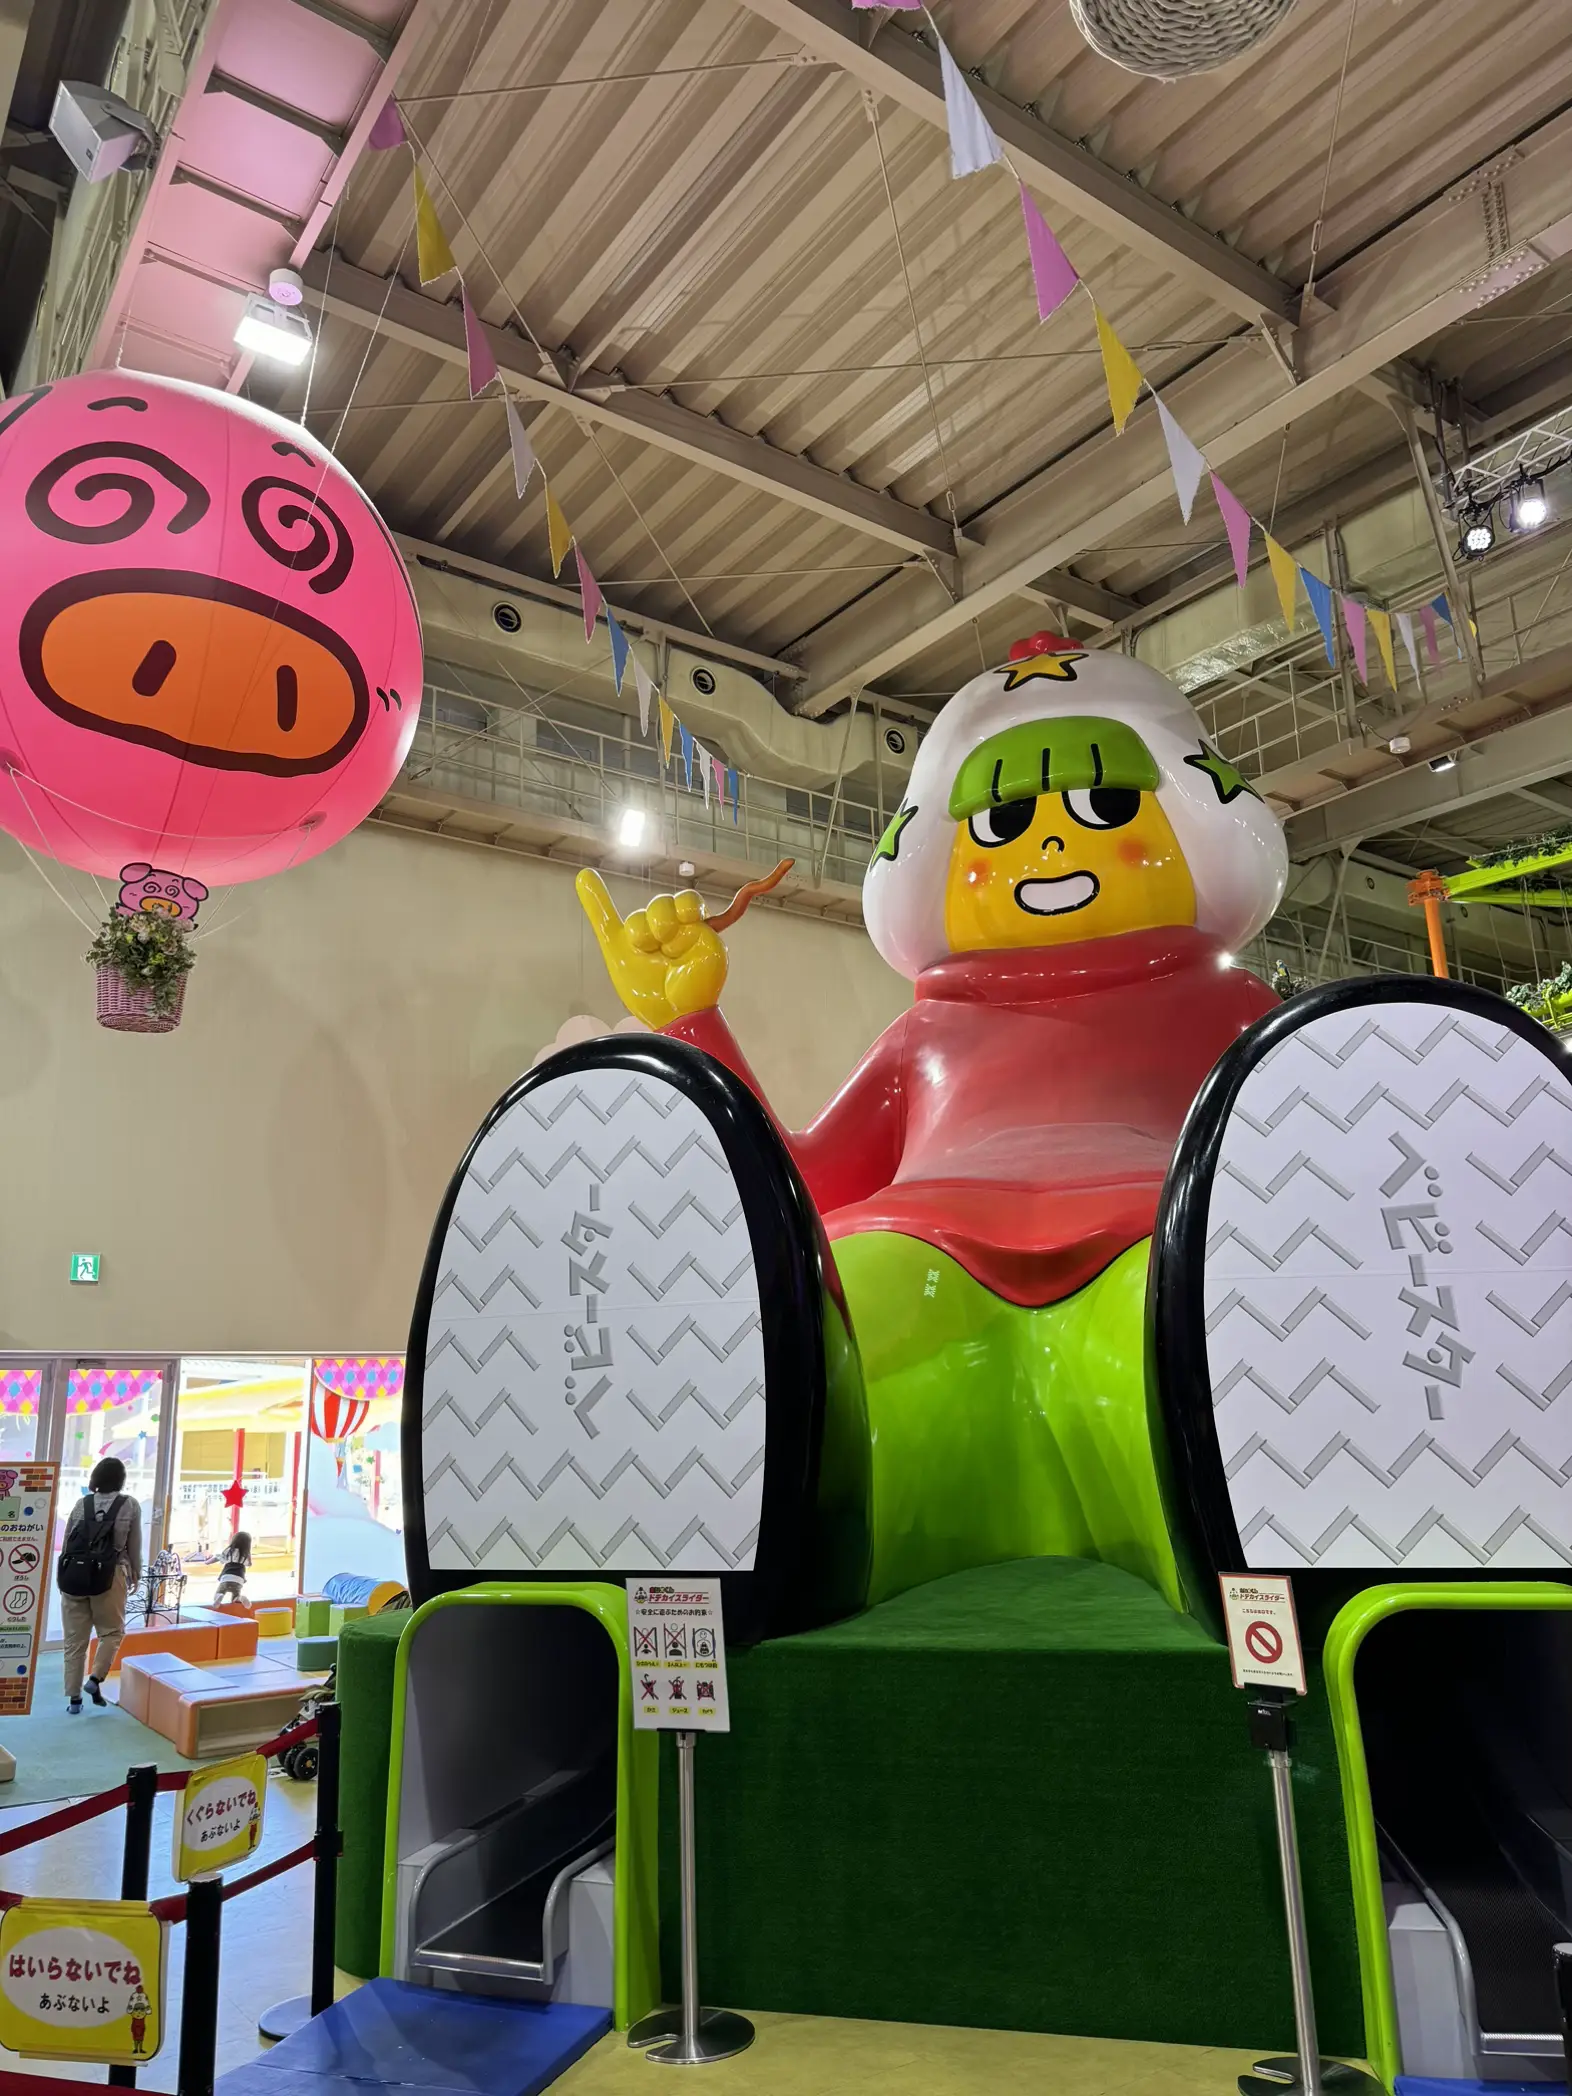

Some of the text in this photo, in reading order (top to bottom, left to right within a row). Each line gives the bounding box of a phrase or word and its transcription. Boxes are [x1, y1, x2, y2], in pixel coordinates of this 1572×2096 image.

[1378, 1131, 1477, 1421] ベビースター
[559, 1182, 614, 1440] ベビースター
[1, 1523, 44, 1532] のおねがい
[649, 1594, 710, 1602] ドデカイスライダー
[1240, 1593, 1285, 1601] ドデカイスライダー
[186, 1789, 257, 1826] くぐらないでね
[200, 1819, 241, 1843] あぶないよ
[9, 1954, 142, 1985] はいらないでね
[39, 1992, 110, 2014] あぶないよ
